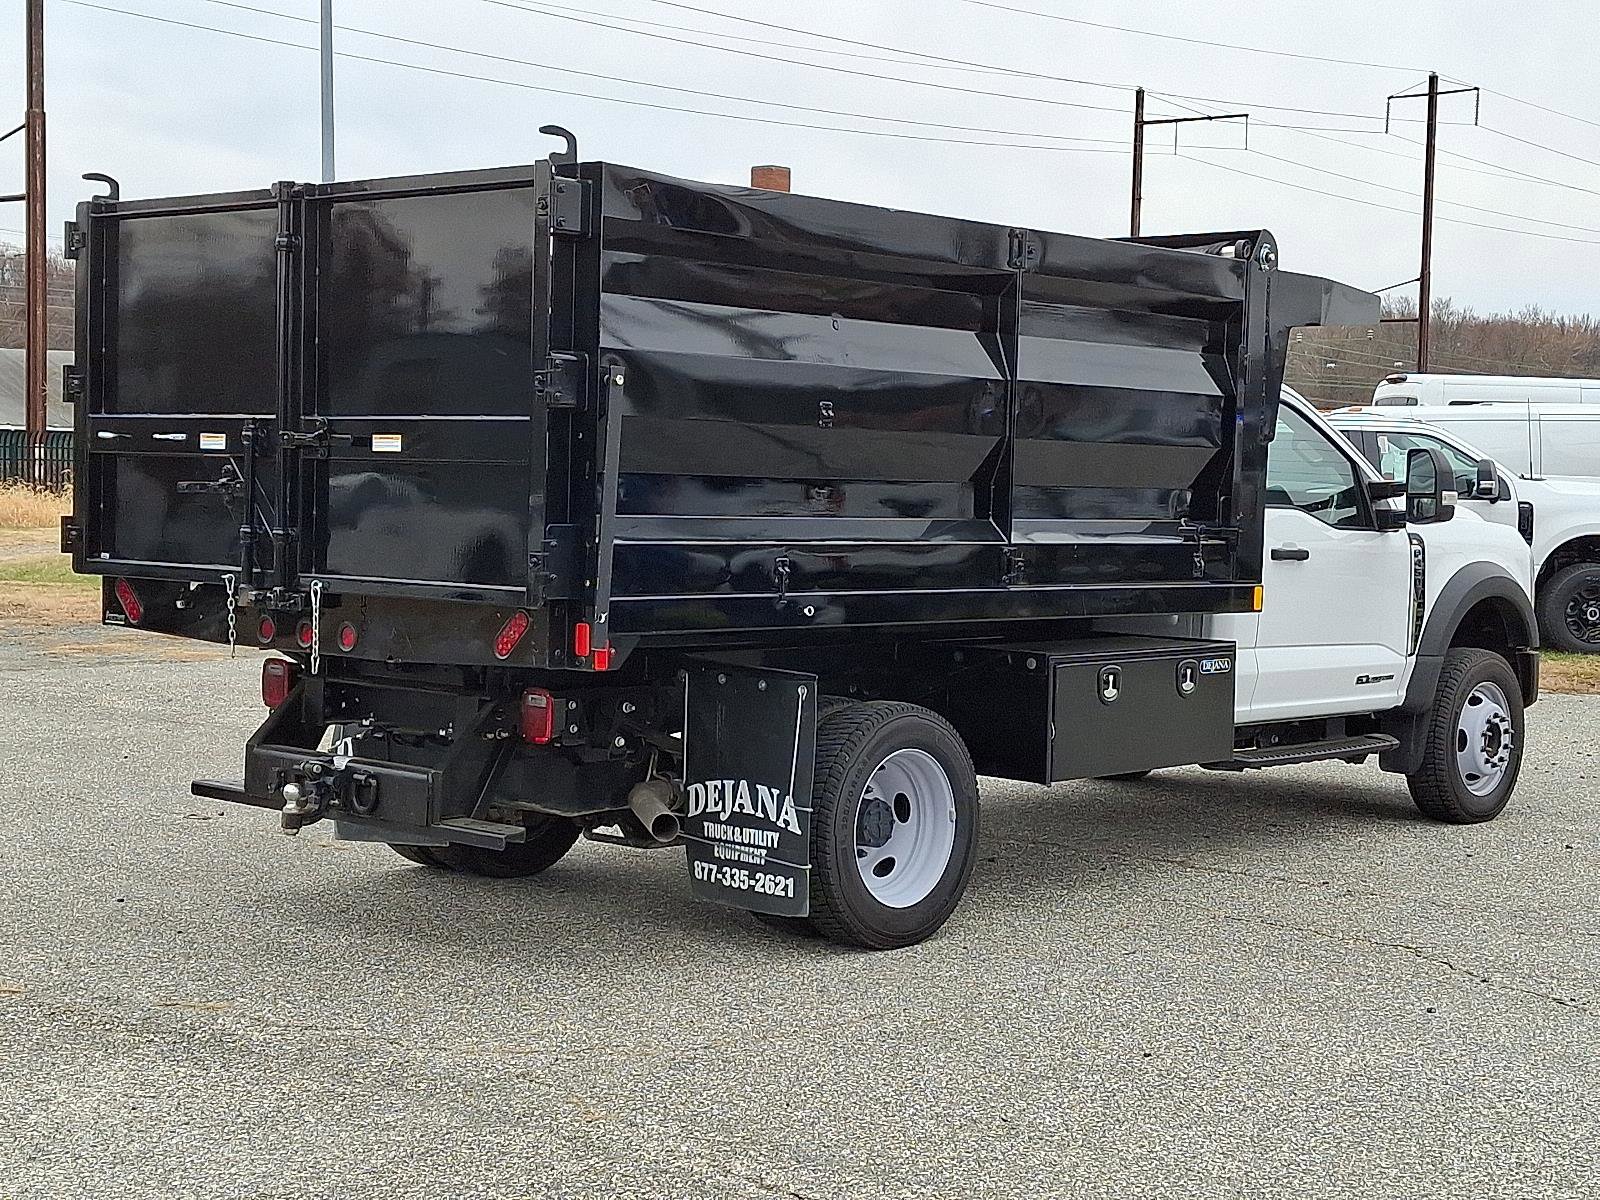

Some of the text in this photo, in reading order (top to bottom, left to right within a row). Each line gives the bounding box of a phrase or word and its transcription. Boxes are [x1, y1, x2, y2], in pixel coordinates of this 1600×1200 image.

[1202, 659, 1229, 671] DEJANA
[686, 779, 802, 836] DEJANA
[714, 842, 768, 866] EQUIPMENT
[693, 860, 795, 898] 877-335-2621
